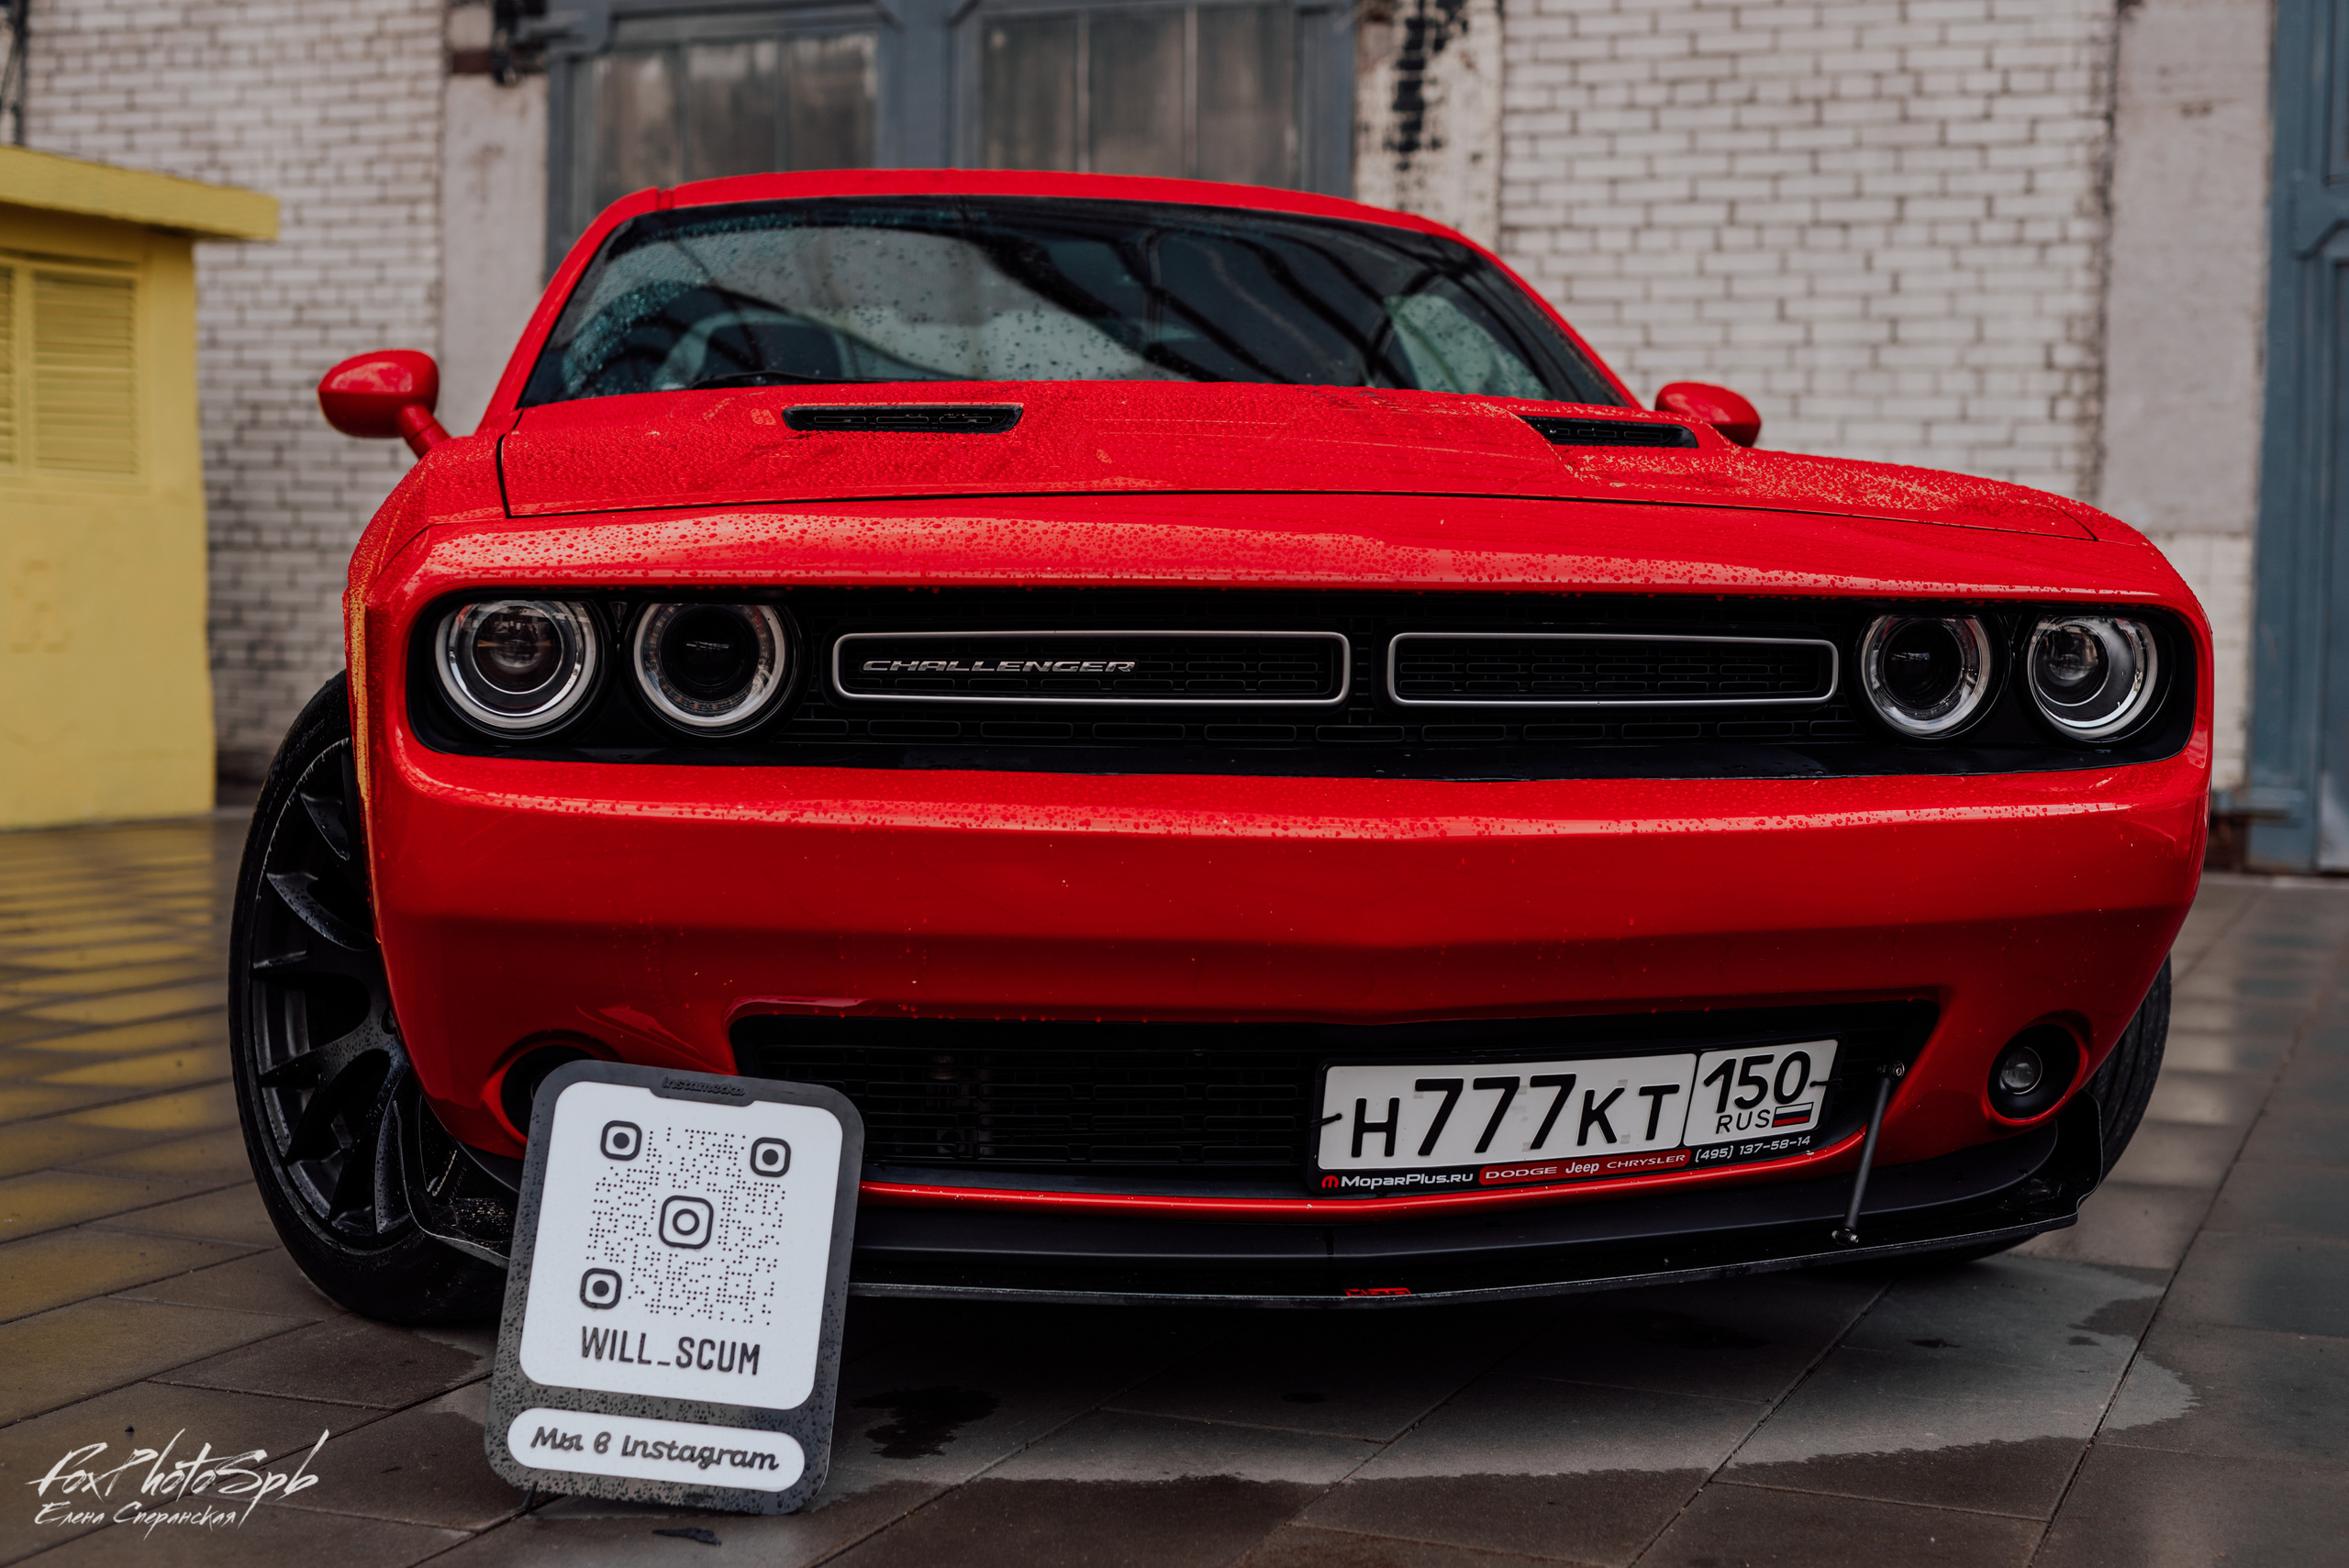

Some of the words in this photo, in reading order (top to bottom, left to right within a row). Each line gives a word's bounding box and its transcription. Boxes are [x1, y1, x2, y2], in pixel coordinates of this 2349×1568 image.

[863, 661, 1136, 673] CHALLENGER
[1703, 1051, 1810, 1113] 150
[1716, 1109, 1770, 1134] RUS
[1486, 1166, 1558, 1179] DODGE
[1565, 1162, 1599, 1174] Jeep
[1607, 1154, 1687, 1169] CHRYSLER
[1695, 1145, 1734, 1162] (495)
[1740, 1136, 1810, 1155] 137-58-14
[582, 1326, 761, 1375] WILL_SCUM
[530, 1426, 584, 1451] Мы
[621, 1435, 779, 1470] Instagram
